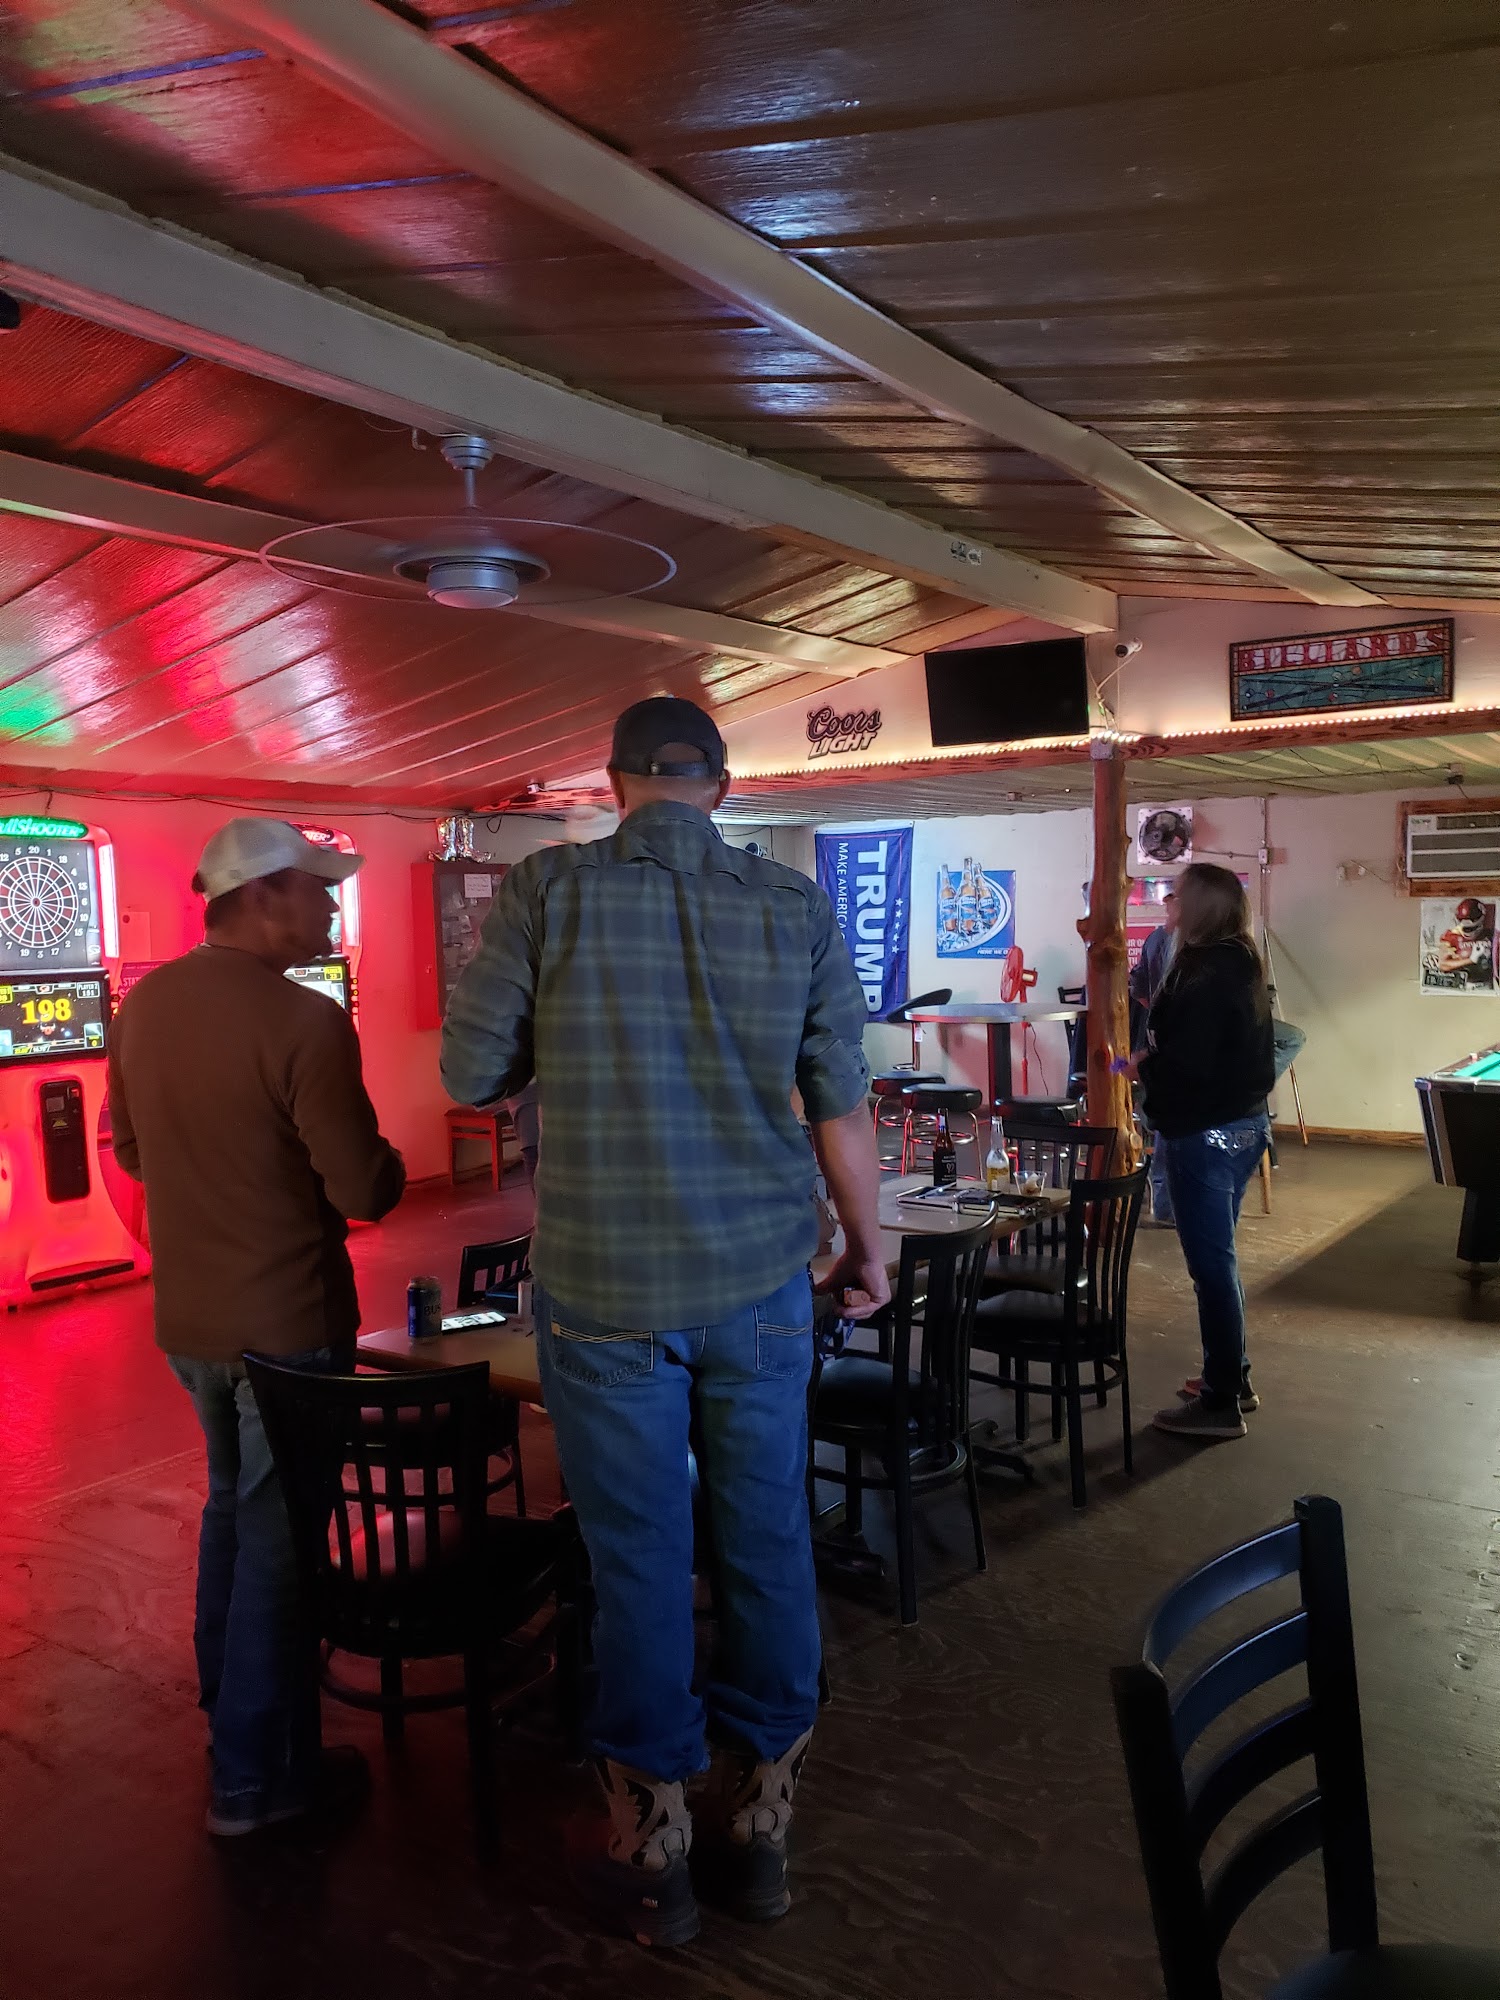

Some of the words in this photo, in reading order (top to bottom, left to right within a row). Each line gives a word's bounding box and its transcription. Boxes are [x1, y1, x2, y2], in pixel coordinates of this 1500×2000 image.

[1238, 629, 1449, 672] BILLIARDS
[806, 706, 882, 742] Coors
[808, 732, 877, 760] LIGHT
[836, 842, 849, 875] MAKE
[71, 868, 77, 876] 4
[78, 882, 88, 890] 13
[82, 898, 88, 906] 6
[75, 928, 83, 936] 15
[854, 841, 887, 1012] TRUMP
[6, 942, 12, 950] 7
[20, 949, 30, 957] 19
[21, 998, 71, 1024] 198
